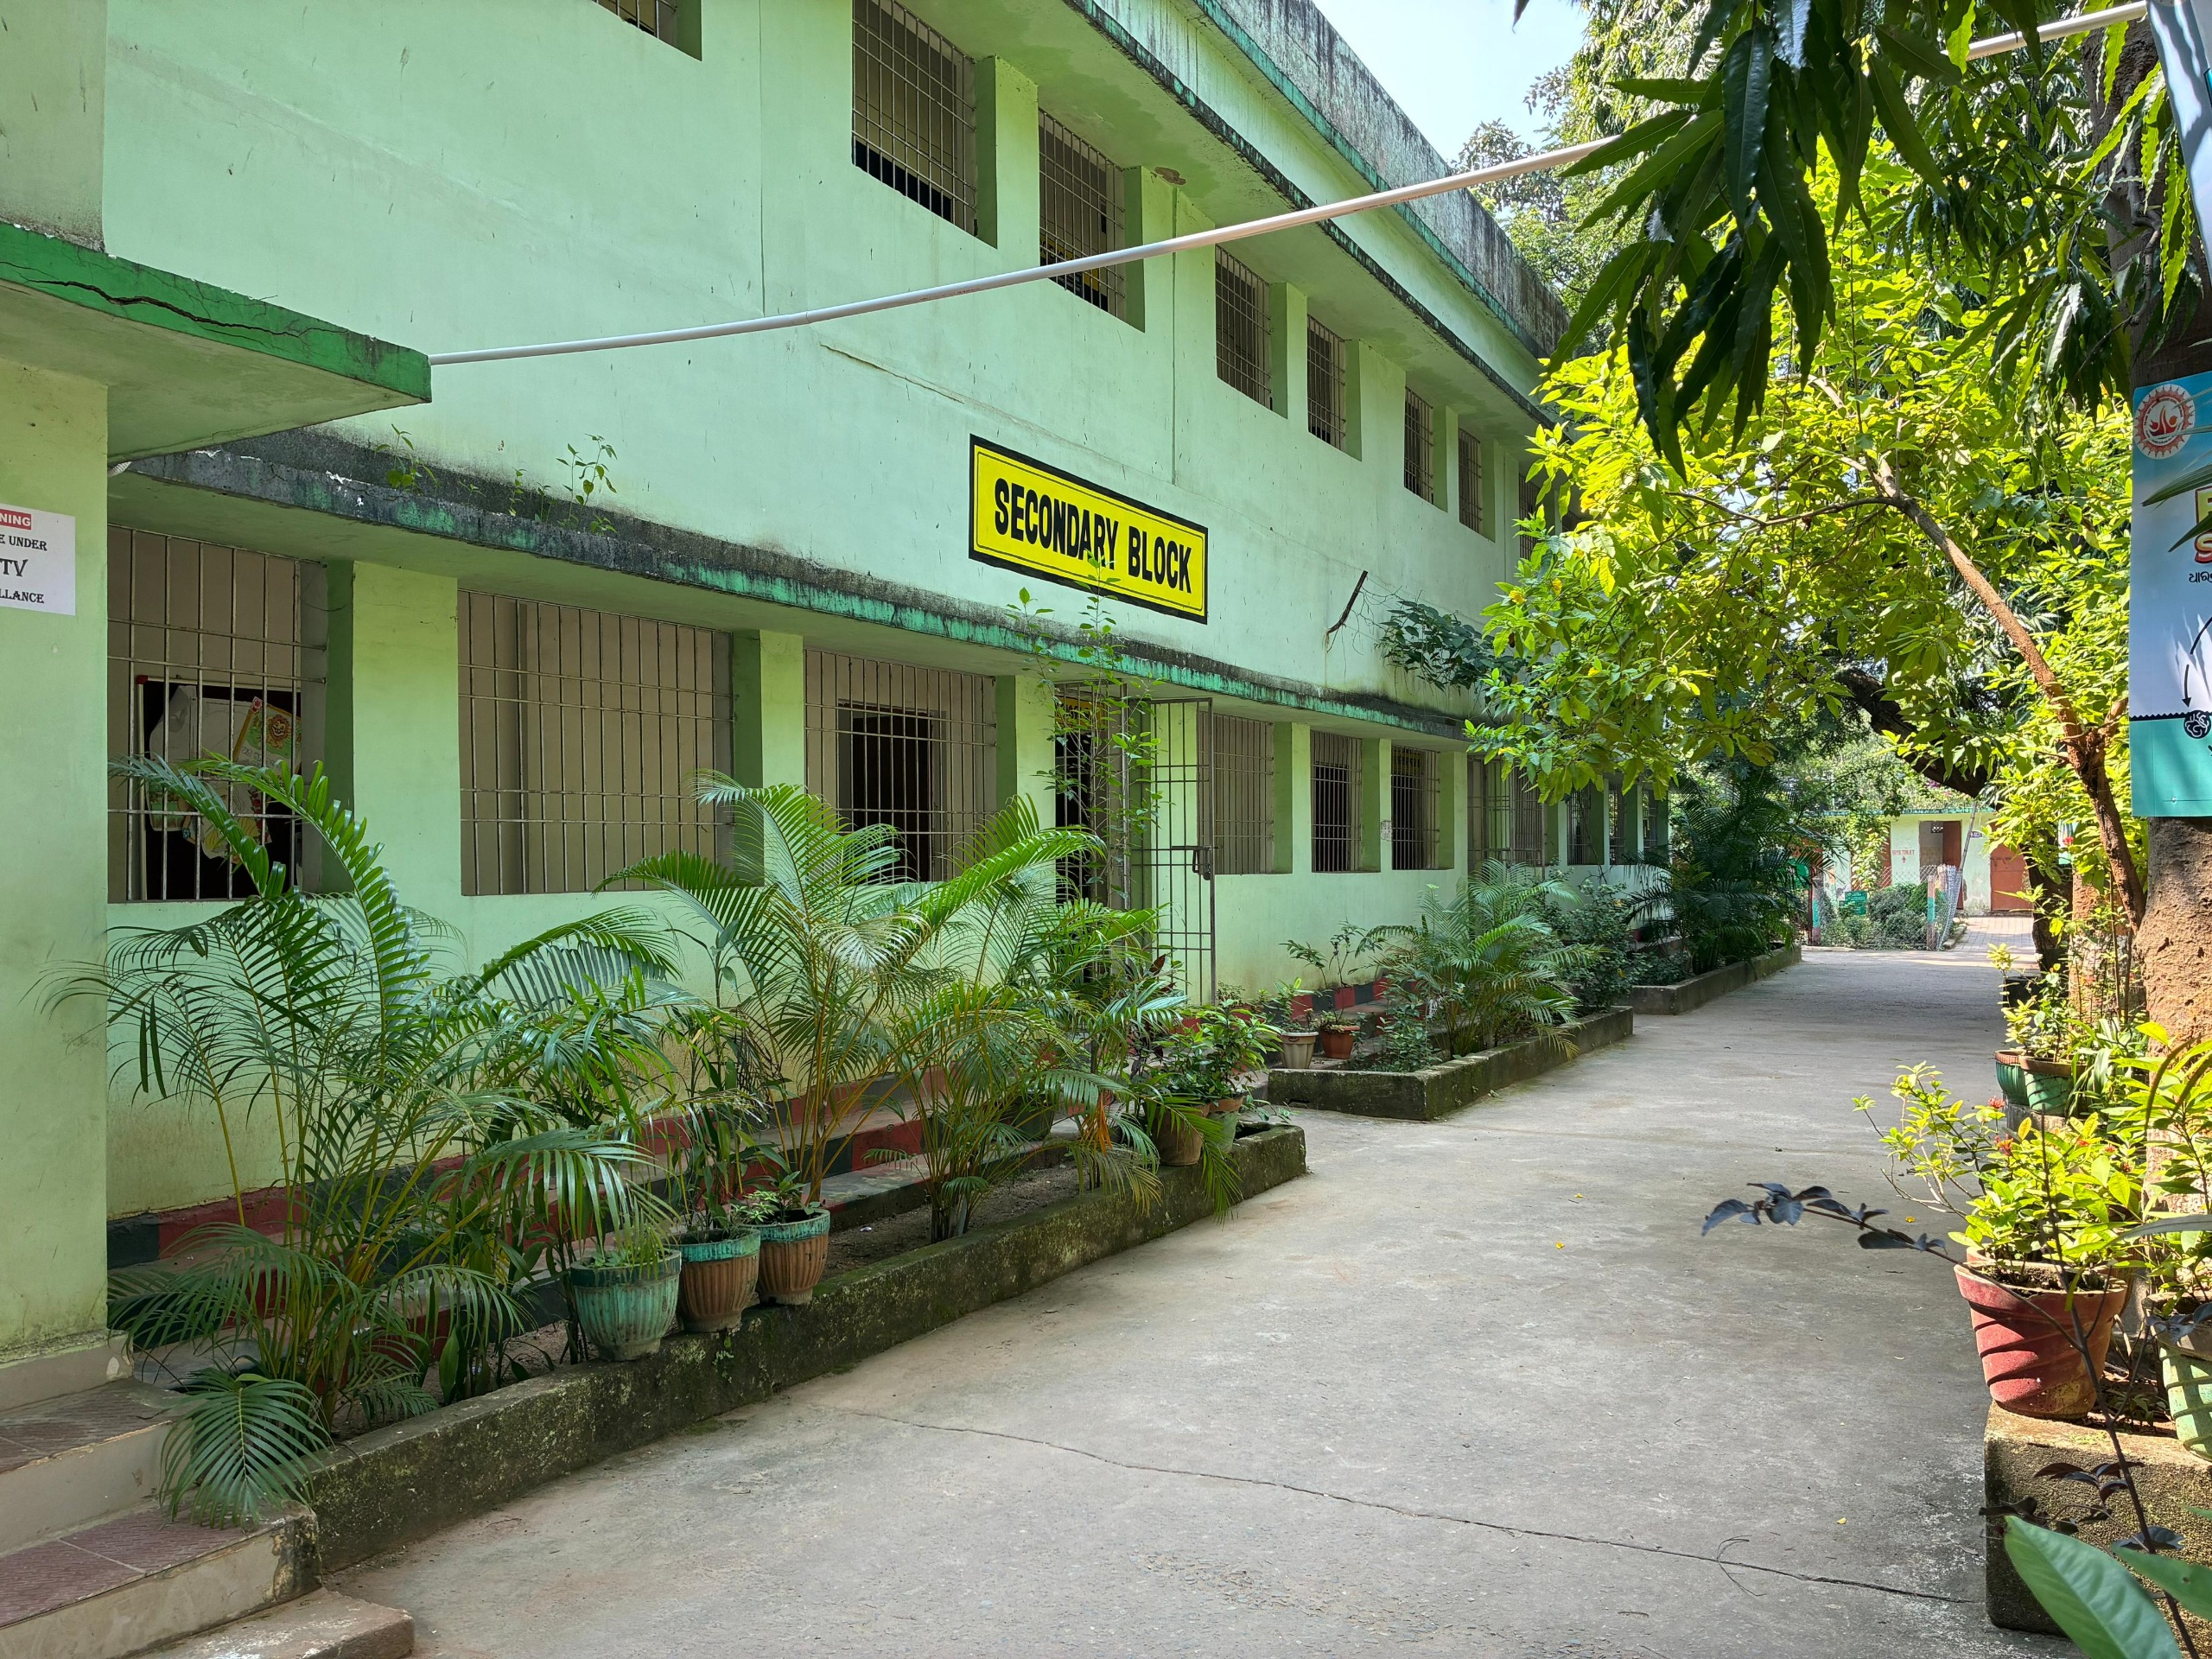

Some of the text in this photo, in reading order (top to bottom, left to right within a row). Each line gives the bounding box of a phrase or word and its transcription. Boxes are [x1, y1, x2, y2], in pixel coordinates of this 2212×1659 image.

[9, 535, 48, 551] UNDER
[995, 477, 1192, 594] SECONDARY BLOCK
